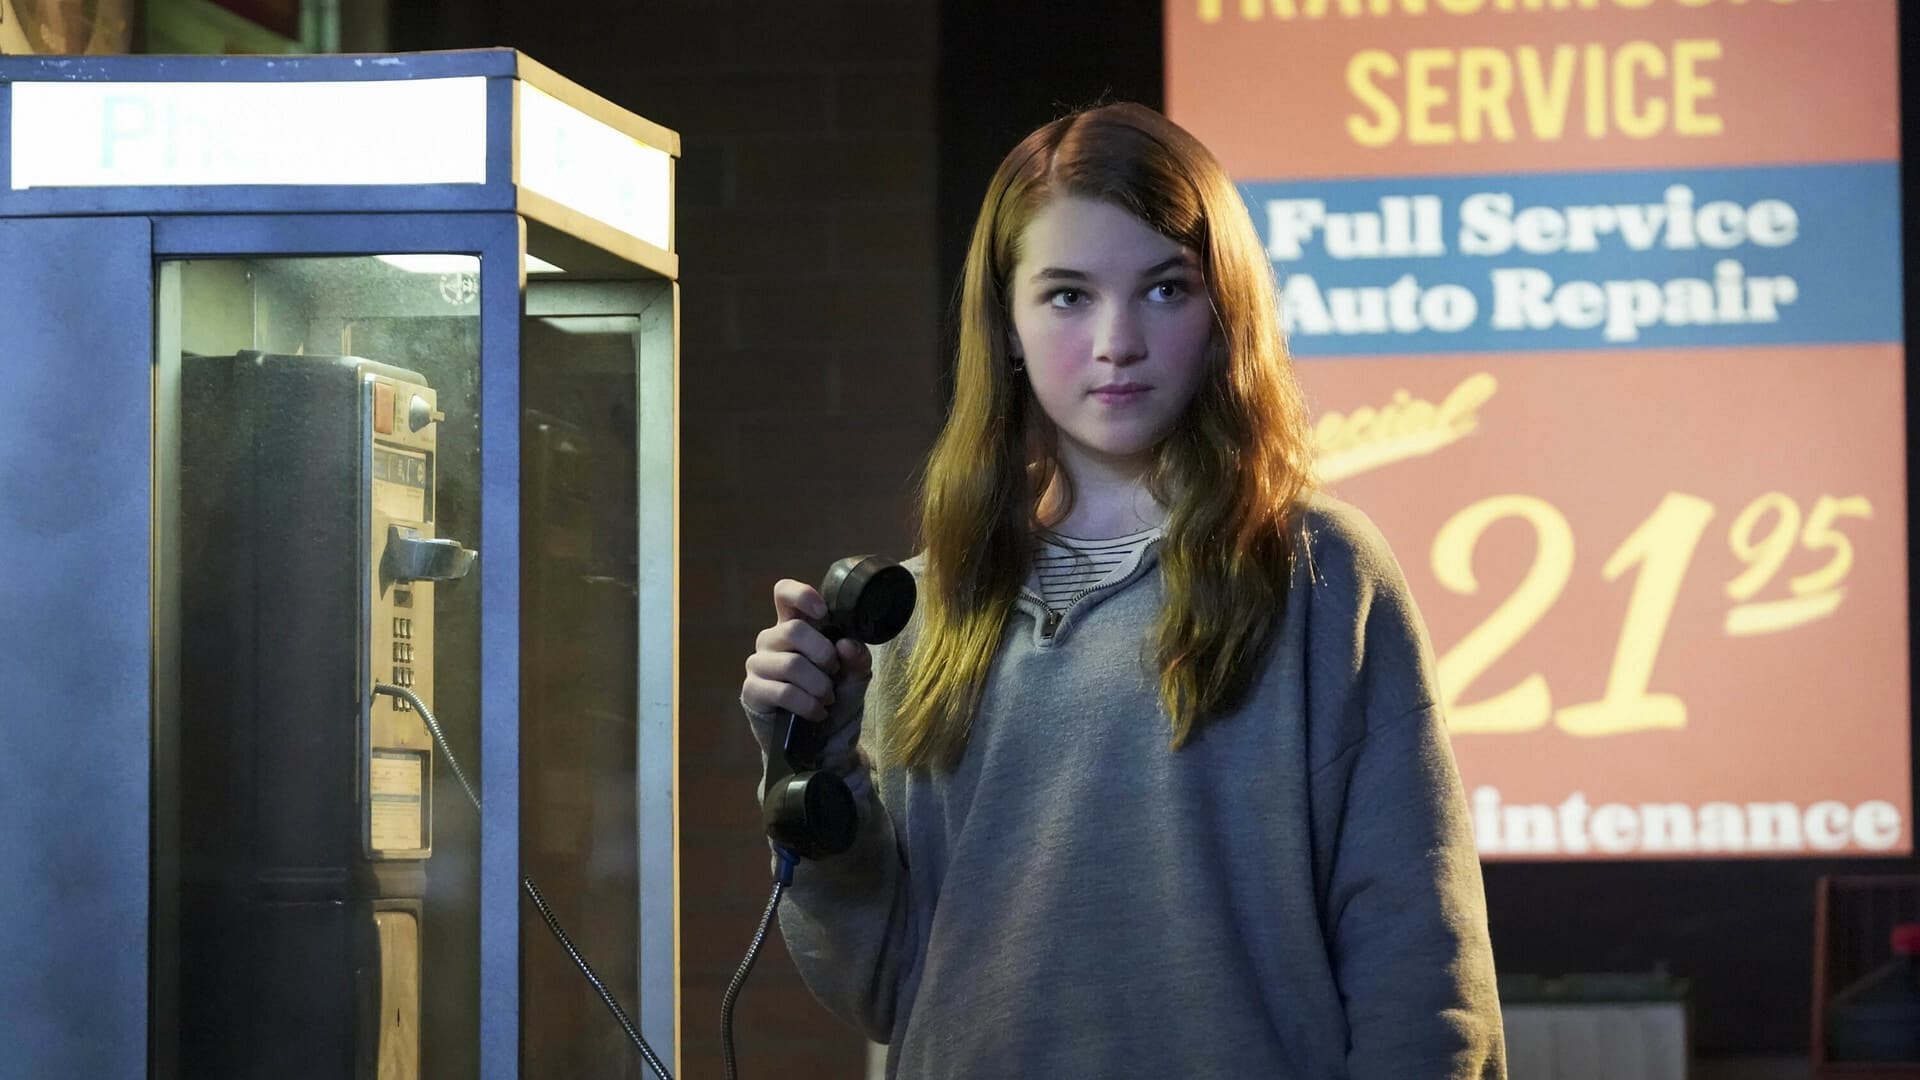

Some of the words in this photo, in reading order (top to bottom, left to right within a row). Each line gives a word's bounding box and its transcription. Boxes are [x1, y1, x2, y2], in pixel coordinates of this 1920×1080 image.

[1346, 40, 1723, 146] SERVICE
[1268, 195, 1446, 260] Full
[1459, 185, 1798, 254] Service
[1282, 273, 1478, 335] Auto
[1491, 260, 1798, 341] Repair
[1313, 372, 1498, 452] ecial
[1430, 492, 1715, 737] 21
[1725, 491, 1873, 602] 95
[1472, 785, 1902, 854] intenance
